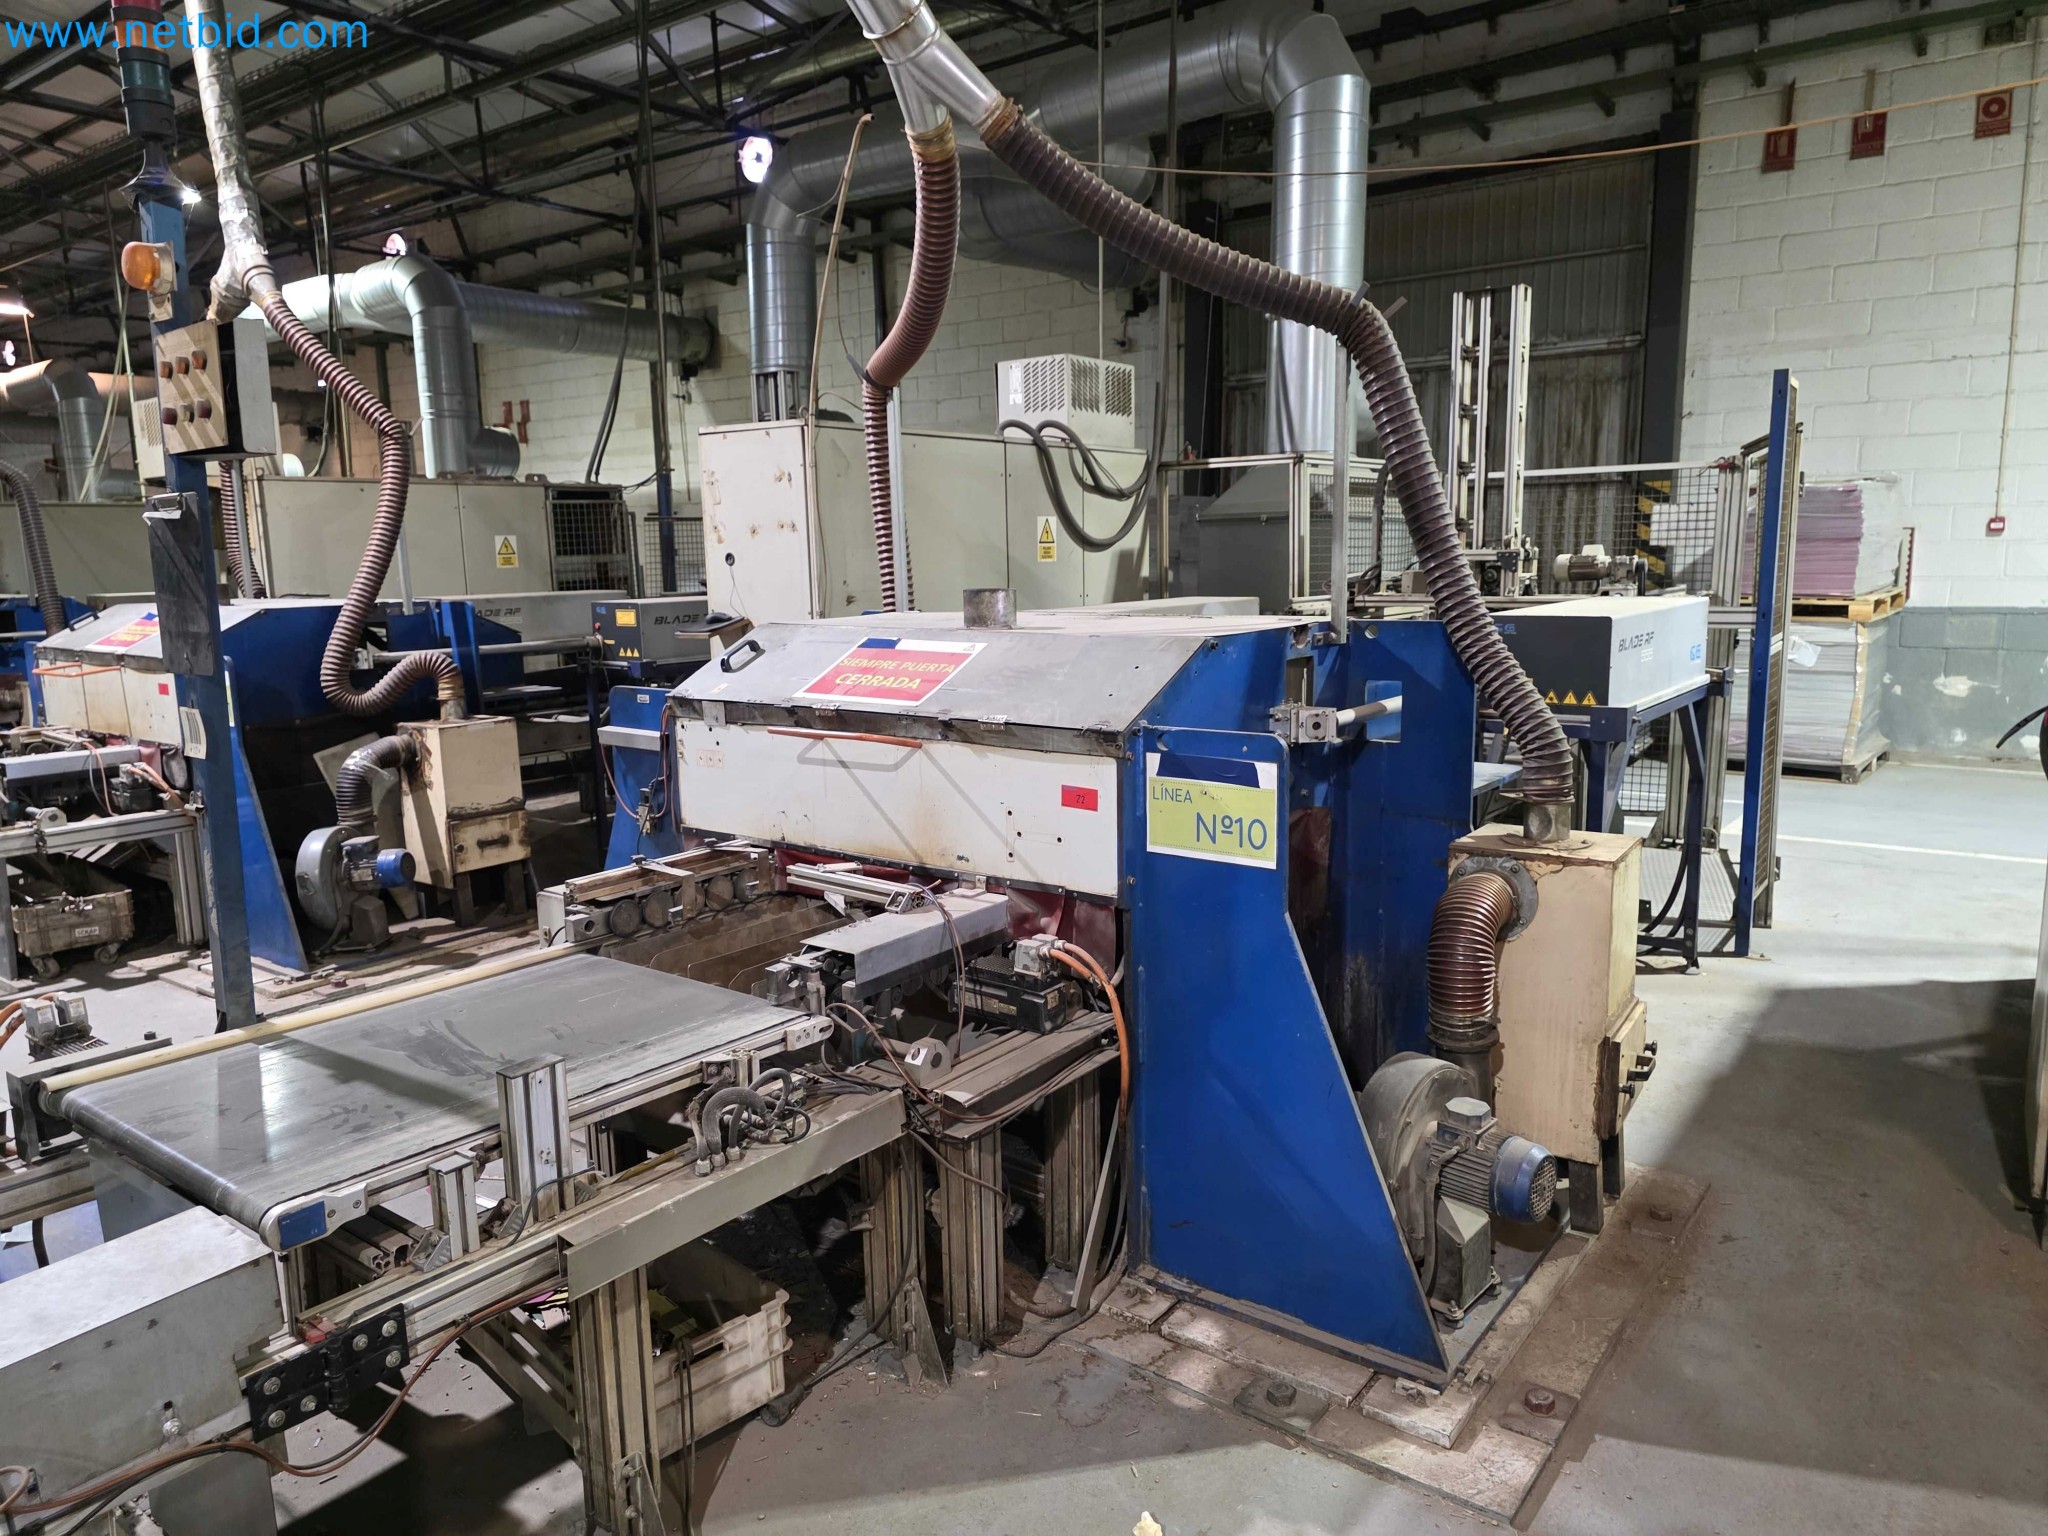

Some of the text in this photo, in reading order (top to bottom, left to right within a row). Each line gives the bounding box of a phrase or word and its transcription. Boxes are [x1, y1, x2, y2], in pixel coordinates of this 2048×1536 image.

[475, 609, 500, 617] ADE
[654, 614, 699, 625] BLADE
[1618, 635, 1643, 652] BLADE
[839, 657, 957, 673] SIEMPRE PUERTA
[835, 673, 922, 689] CERRADA
[1152, 783, 1193, 804] LÍNEA
[1196, 811, 1268, 850] Nº10
